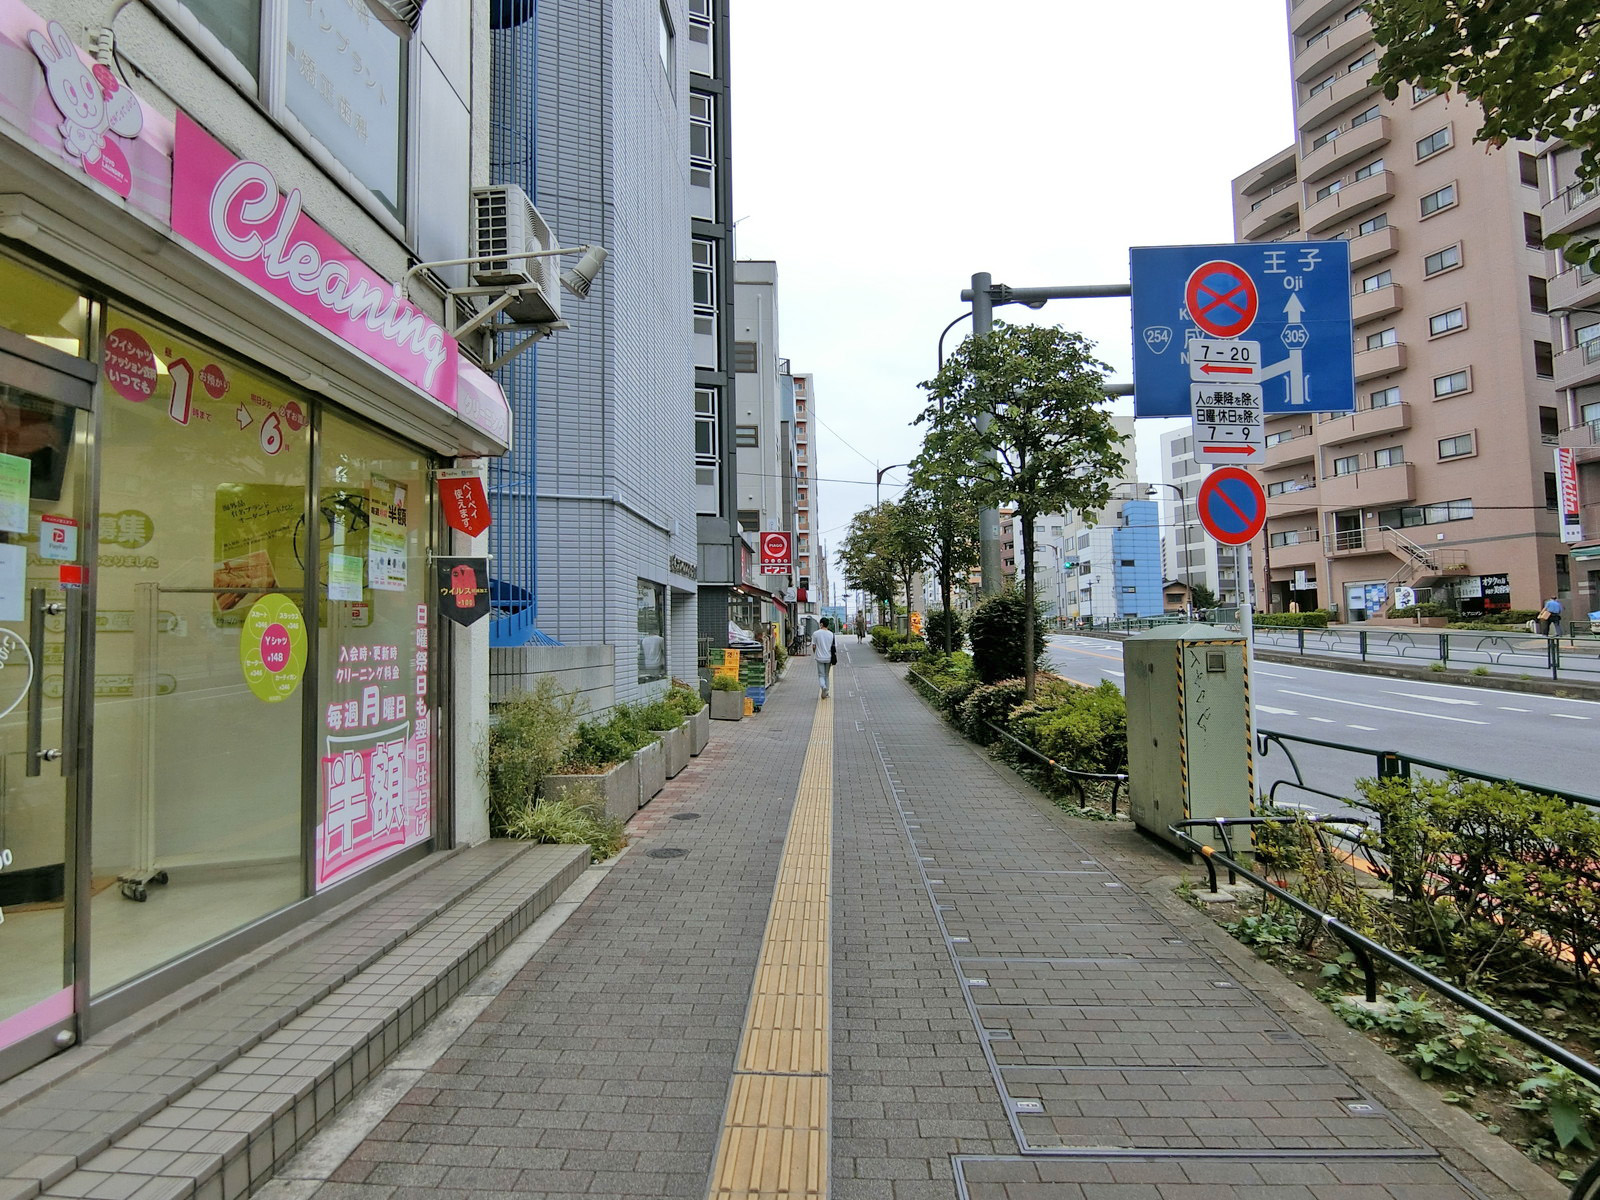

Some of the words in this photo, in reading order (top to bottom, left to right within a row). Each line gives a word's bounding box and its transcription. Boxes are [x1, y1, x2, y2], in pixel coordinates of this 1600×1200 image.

[209, 159, 447, 390] Cleaning
[1263, 248, 1322, 274] 王子
[1283, 275, 1303, 292] Oji
[109, 334, 153, 362] ワイシャツ
[1147, 330, 1169, 343] 254
[1284, 329, 1306, 343] 305
[108, 367, 152, 395] いつでも
[167, 356, 195, 426] 1
[1195, 391, 1259, 406] 人の乗降を除く
[259, 410, 284, 456] 6
[462, 481, 478, 519] ペイペイ
[339, 645, 398, 662] 入会時・更新時
[336, 664, 400, 684] クリーニング料金
[327, 685, 407, 730] 毎週月曜日
[415, 604, 429, 837] 日曜祭日も翌日仕上げ
[327, 740, 407, 855] 半額
